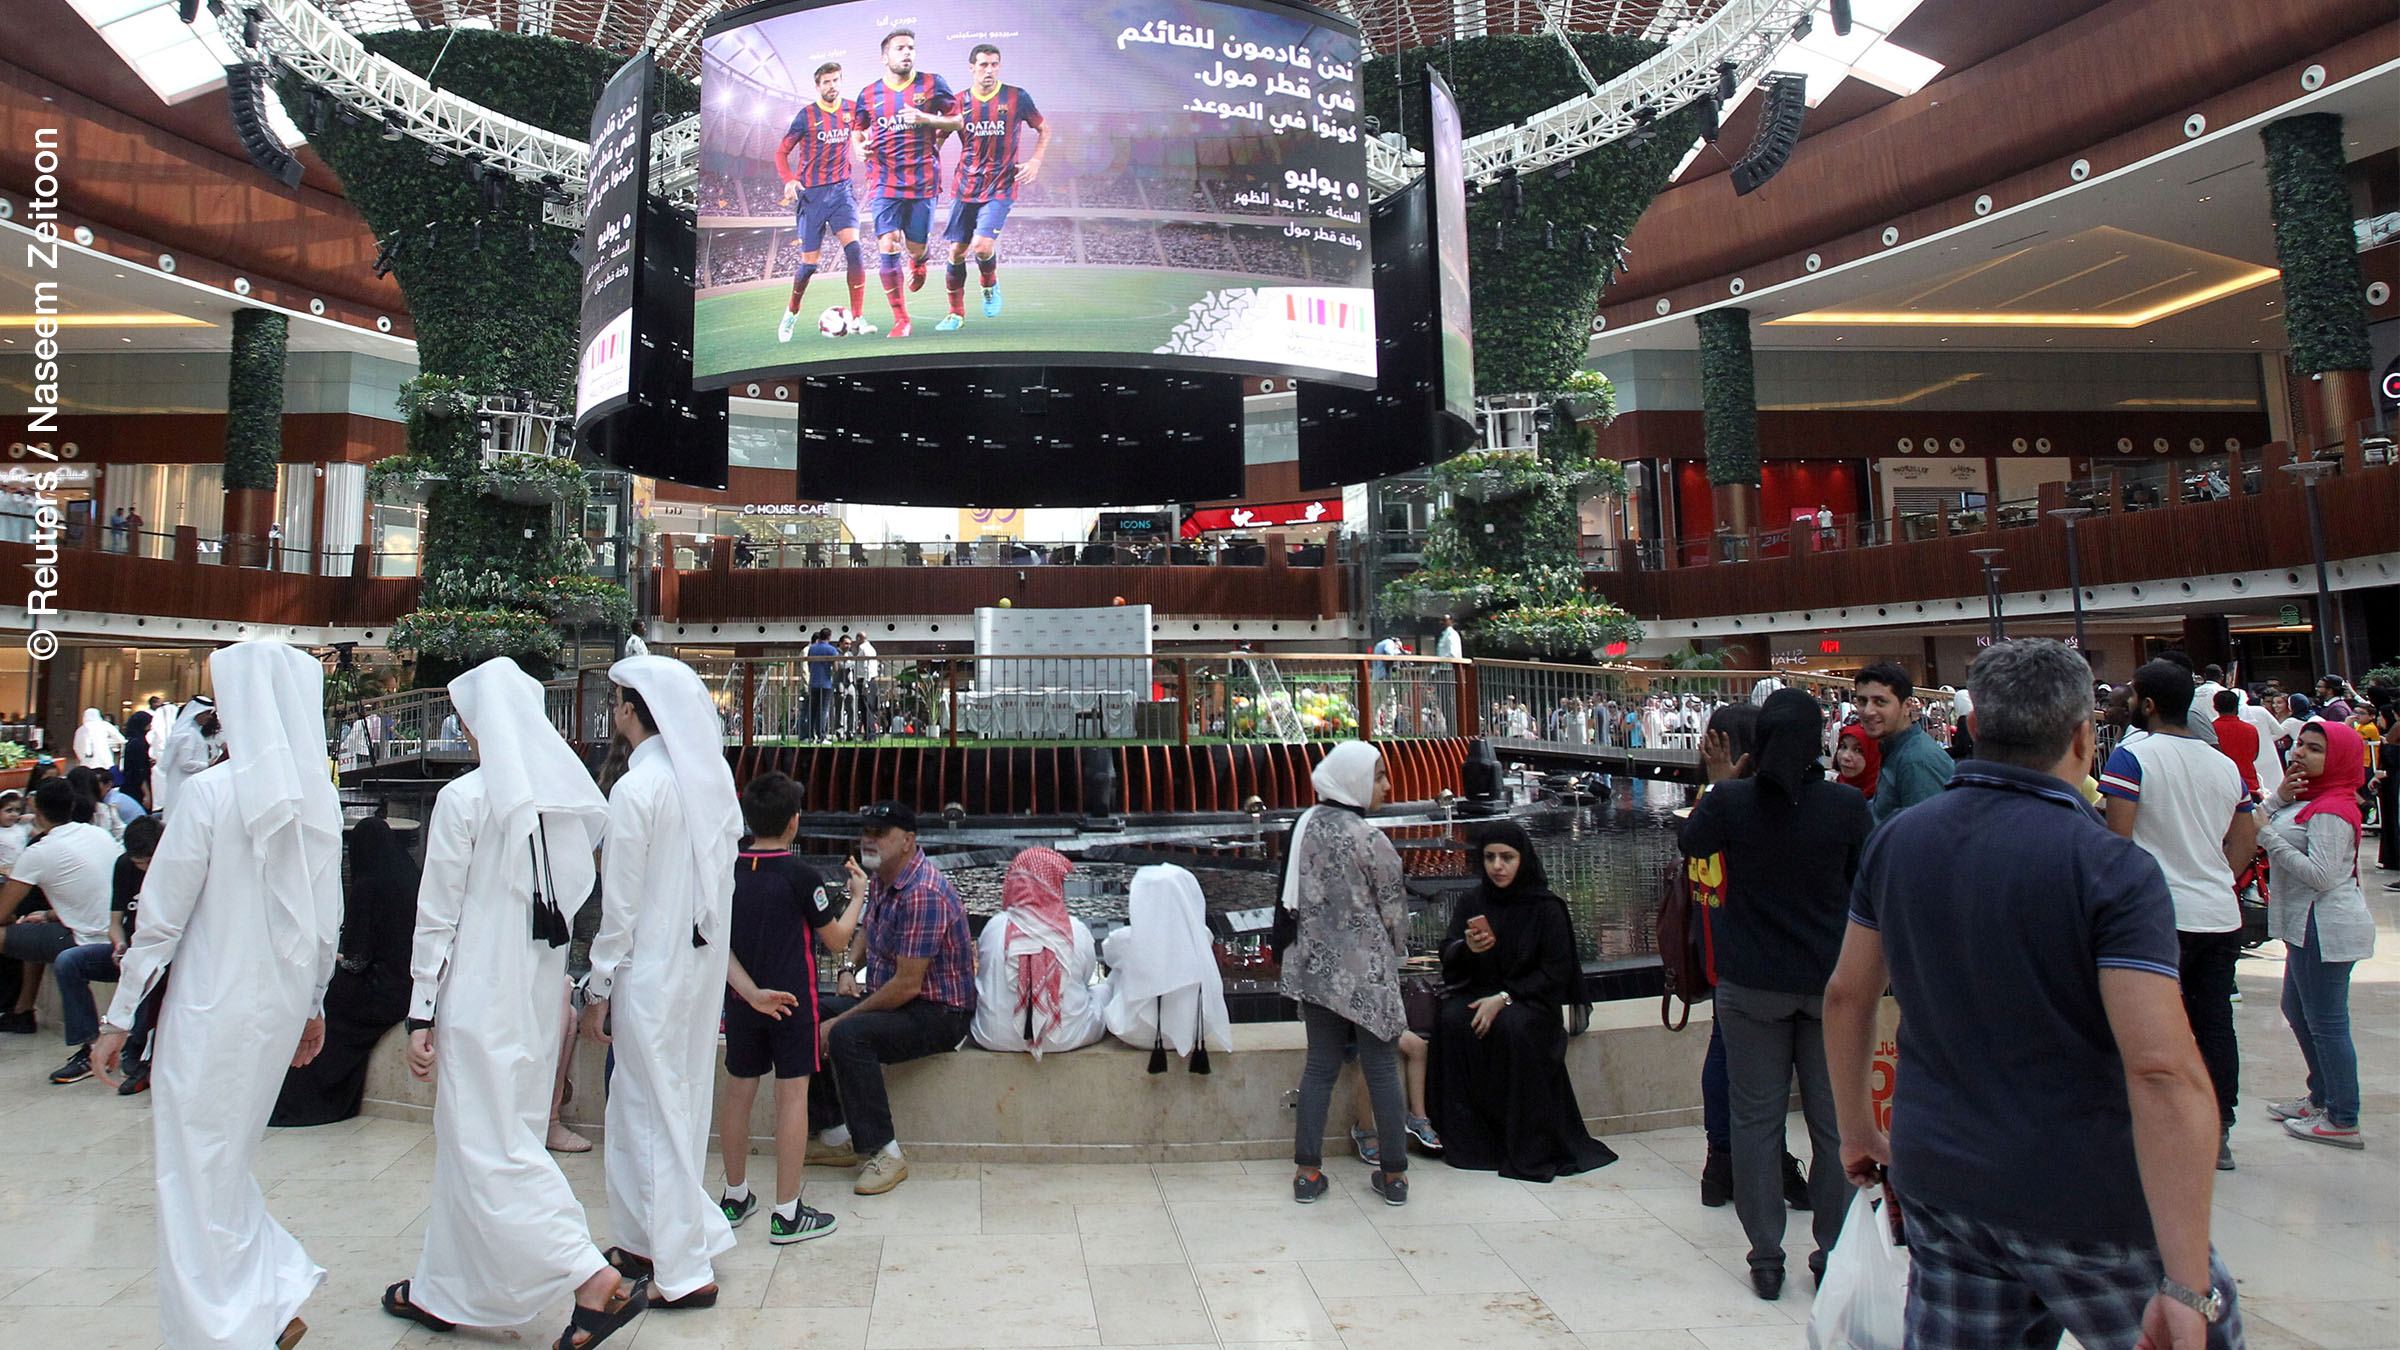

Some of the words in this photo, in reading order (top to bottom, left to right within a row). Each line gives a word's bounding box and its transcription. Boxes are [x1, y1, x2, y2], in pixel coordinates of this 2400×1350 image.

[1116, 20, 1215, 50] للقائكم
[1222, 34, 1311, 69] قادمون
[1194, 61, 1257, 88] مول.
[1317, 54, 1353, 82] نحن
[1265, 72, 1311, 99] قطر
[1183, 97, 1263, 121] الموعد.
[1317, 89, 1355, 116] في
[877, 114, 906, 129] QAT
[965, 120, 1005, 133] QATAR
[1269, 110, 1307, 135] في
[1312, 114, 1358, 143] كونوا
[817, 128, 850, 142] QATAR
[1284, 167, 1341, 202] يوليو
[1233, 189, 1270, 206] الظهر
[1273, 194, 1294, 211] بعد
[1325, 205, 1361, 224] الساعة
[597, 220, 621, 251] يوليو
[1283, 221, 1311, 238] مول
[1312, 225, 1337, 243] قطر
[1338, 233, 1362, 251] واحة
[744, 504, 755, 515] C
[757, 504, 796, 515] HOUSE
[1120, 520, 1152, 529] ICONS
